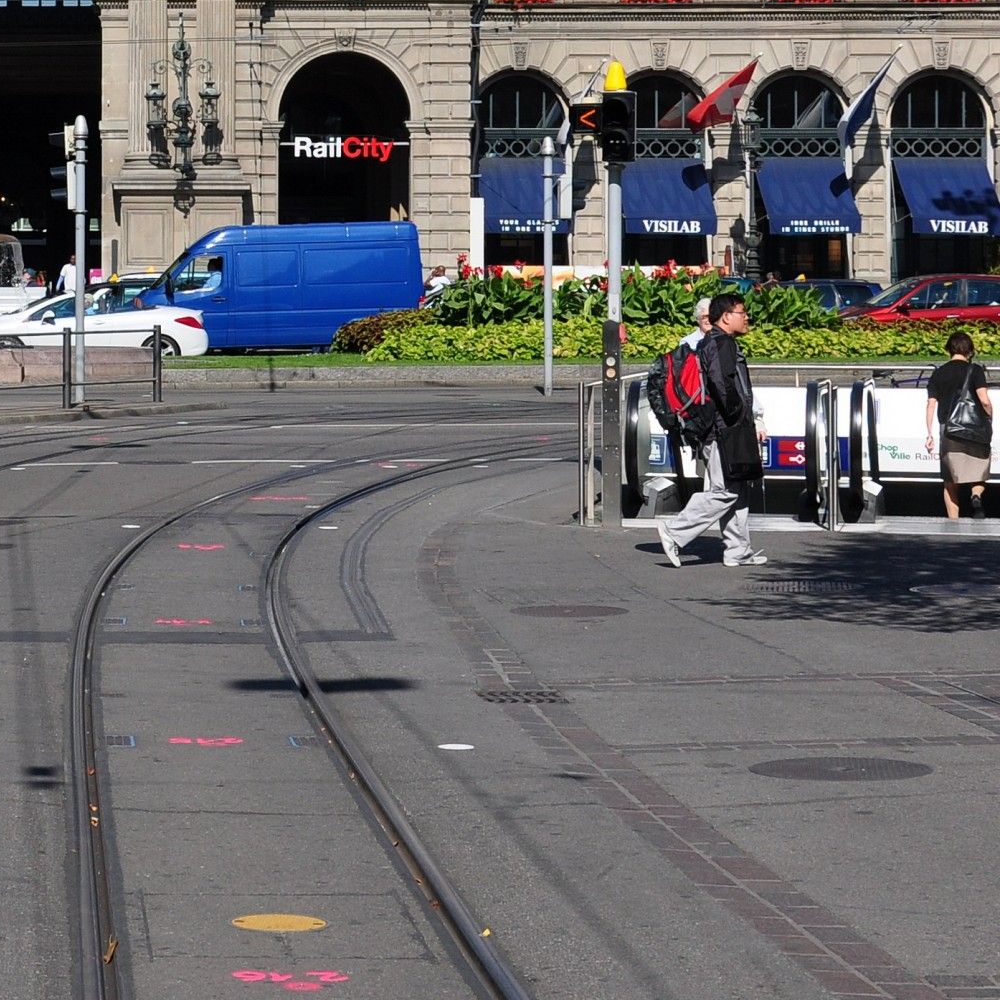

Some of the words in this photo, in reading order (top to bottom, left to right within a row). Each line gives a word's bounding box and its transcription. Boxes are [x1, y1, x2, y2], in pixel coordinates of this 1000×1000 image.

[294, 136, 393, 162] RailCity
[642, 219, 701, 234] VISILAB
[929, 219, 989, 233] VISILAB
